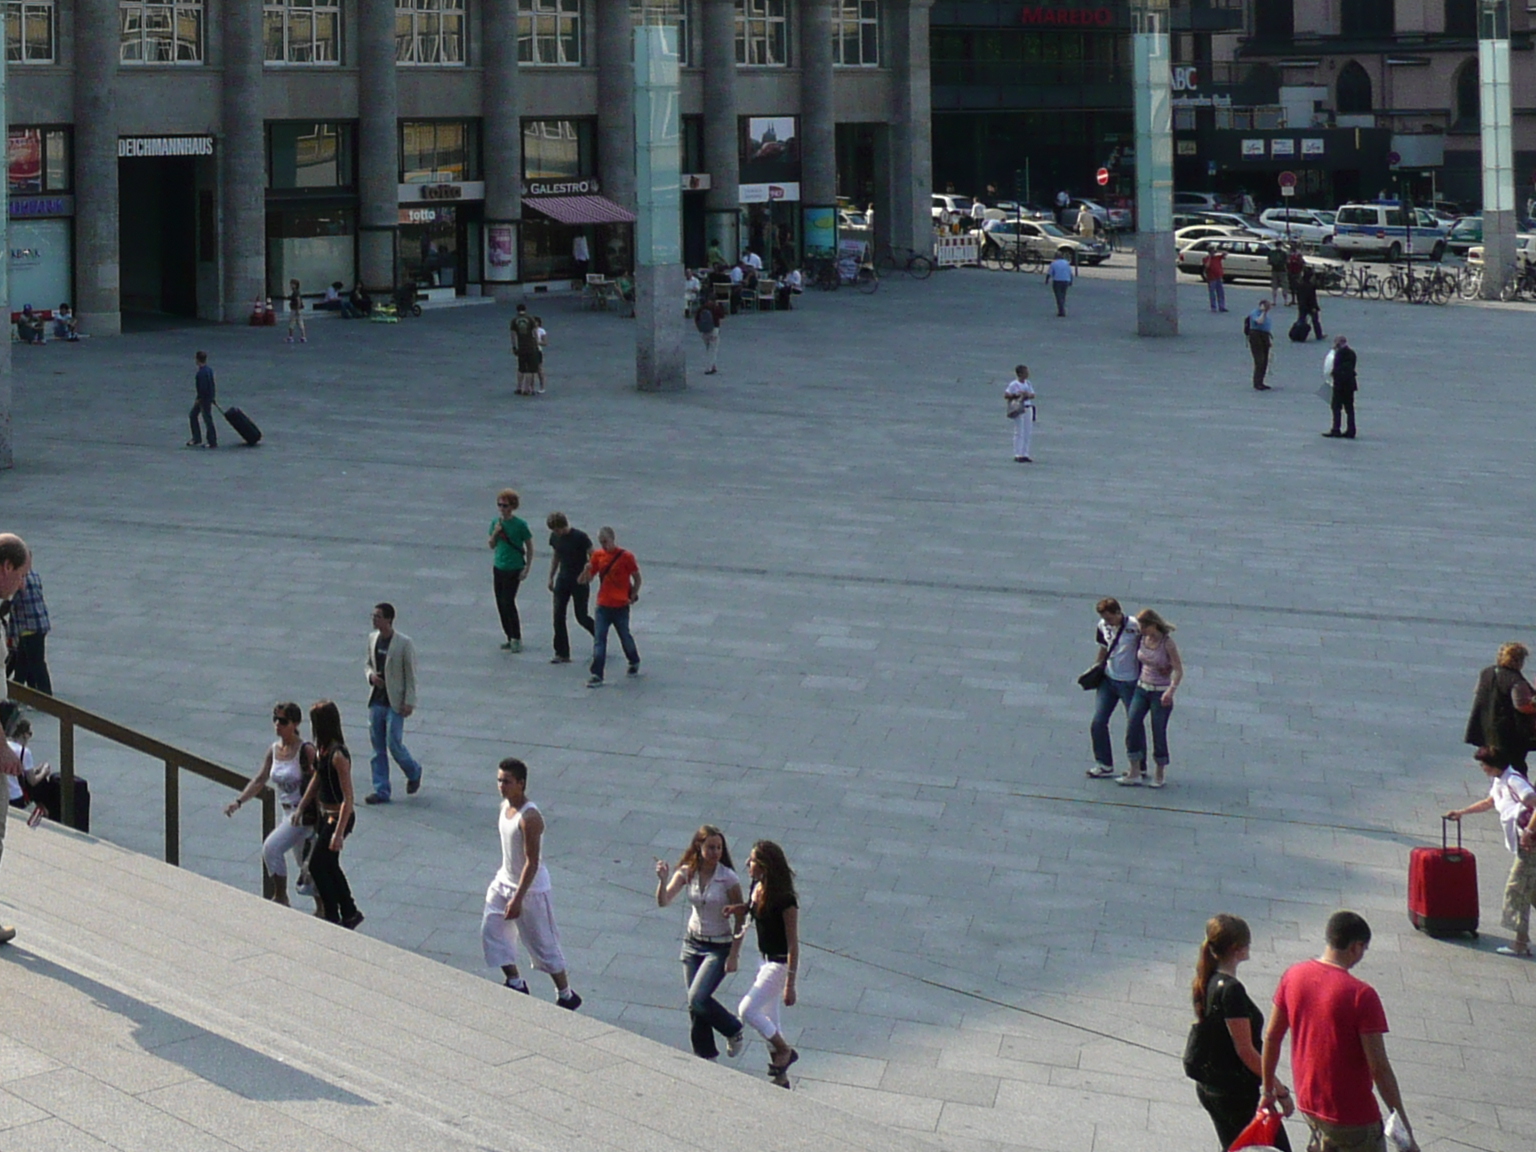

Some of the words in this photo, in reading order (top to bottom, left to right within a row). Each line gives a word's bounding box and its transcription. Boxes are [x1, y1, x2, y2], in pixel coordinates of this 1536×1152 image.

[1020, 5, 1113, 28] MAREDO
[117, 136, 214, 158] DEICHMANNHAUS
[529, 180, 590, 195] GALESTRO
